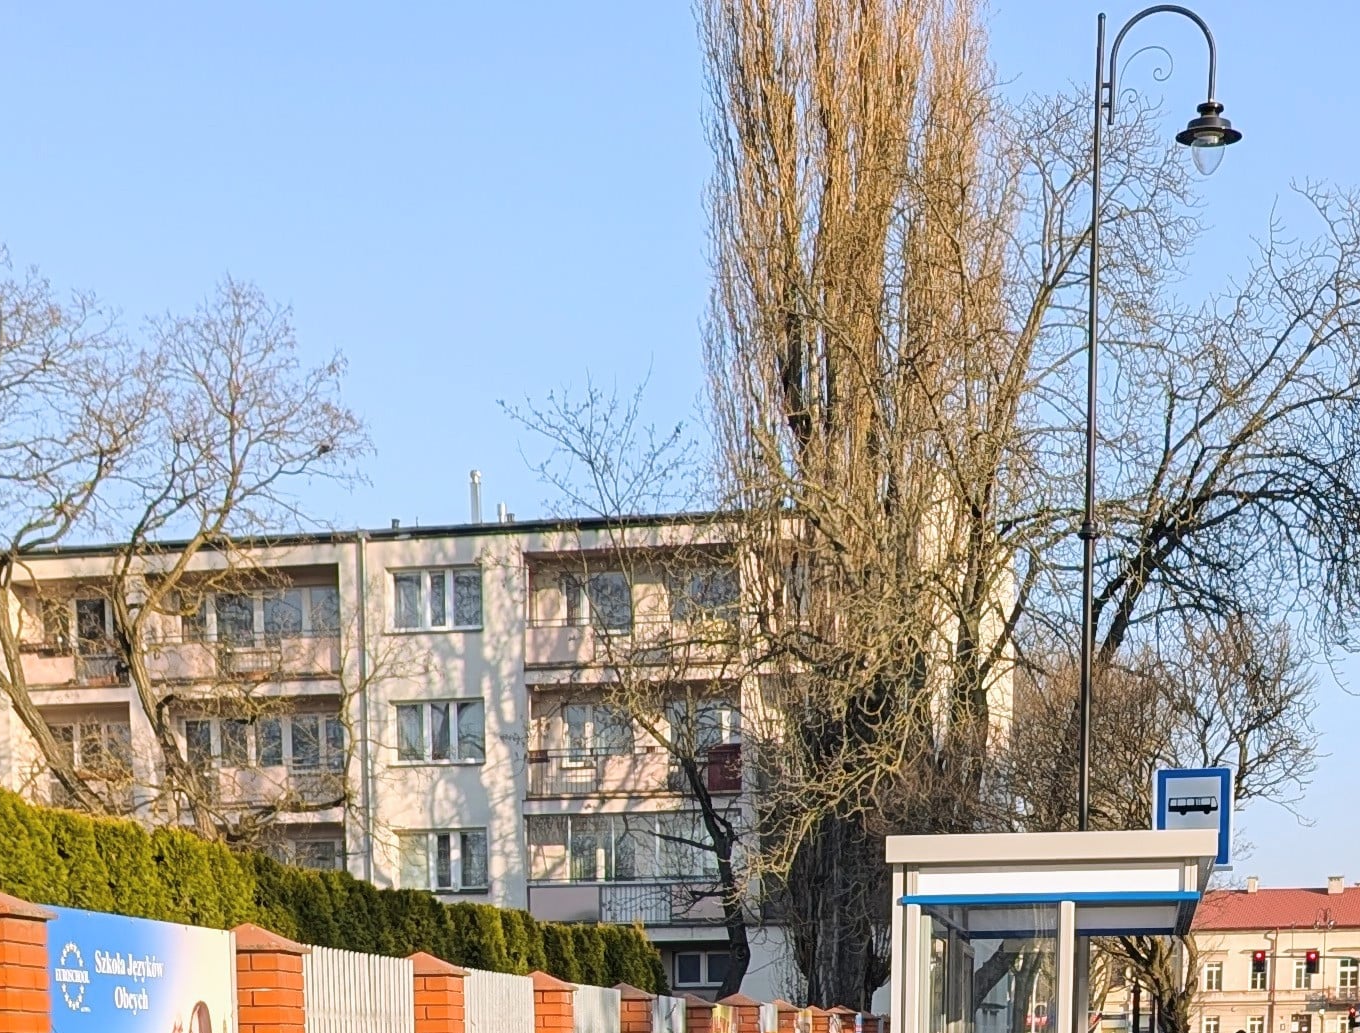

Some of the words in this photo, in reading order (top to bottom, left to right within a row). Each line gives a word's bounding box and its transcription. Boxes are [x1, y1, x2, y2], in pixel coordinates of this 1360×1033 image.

[94, 950, 126, 975] Szkoła
[127, 953, 165, 983] Języków
[114, 986, 149, 1016] Obcych
